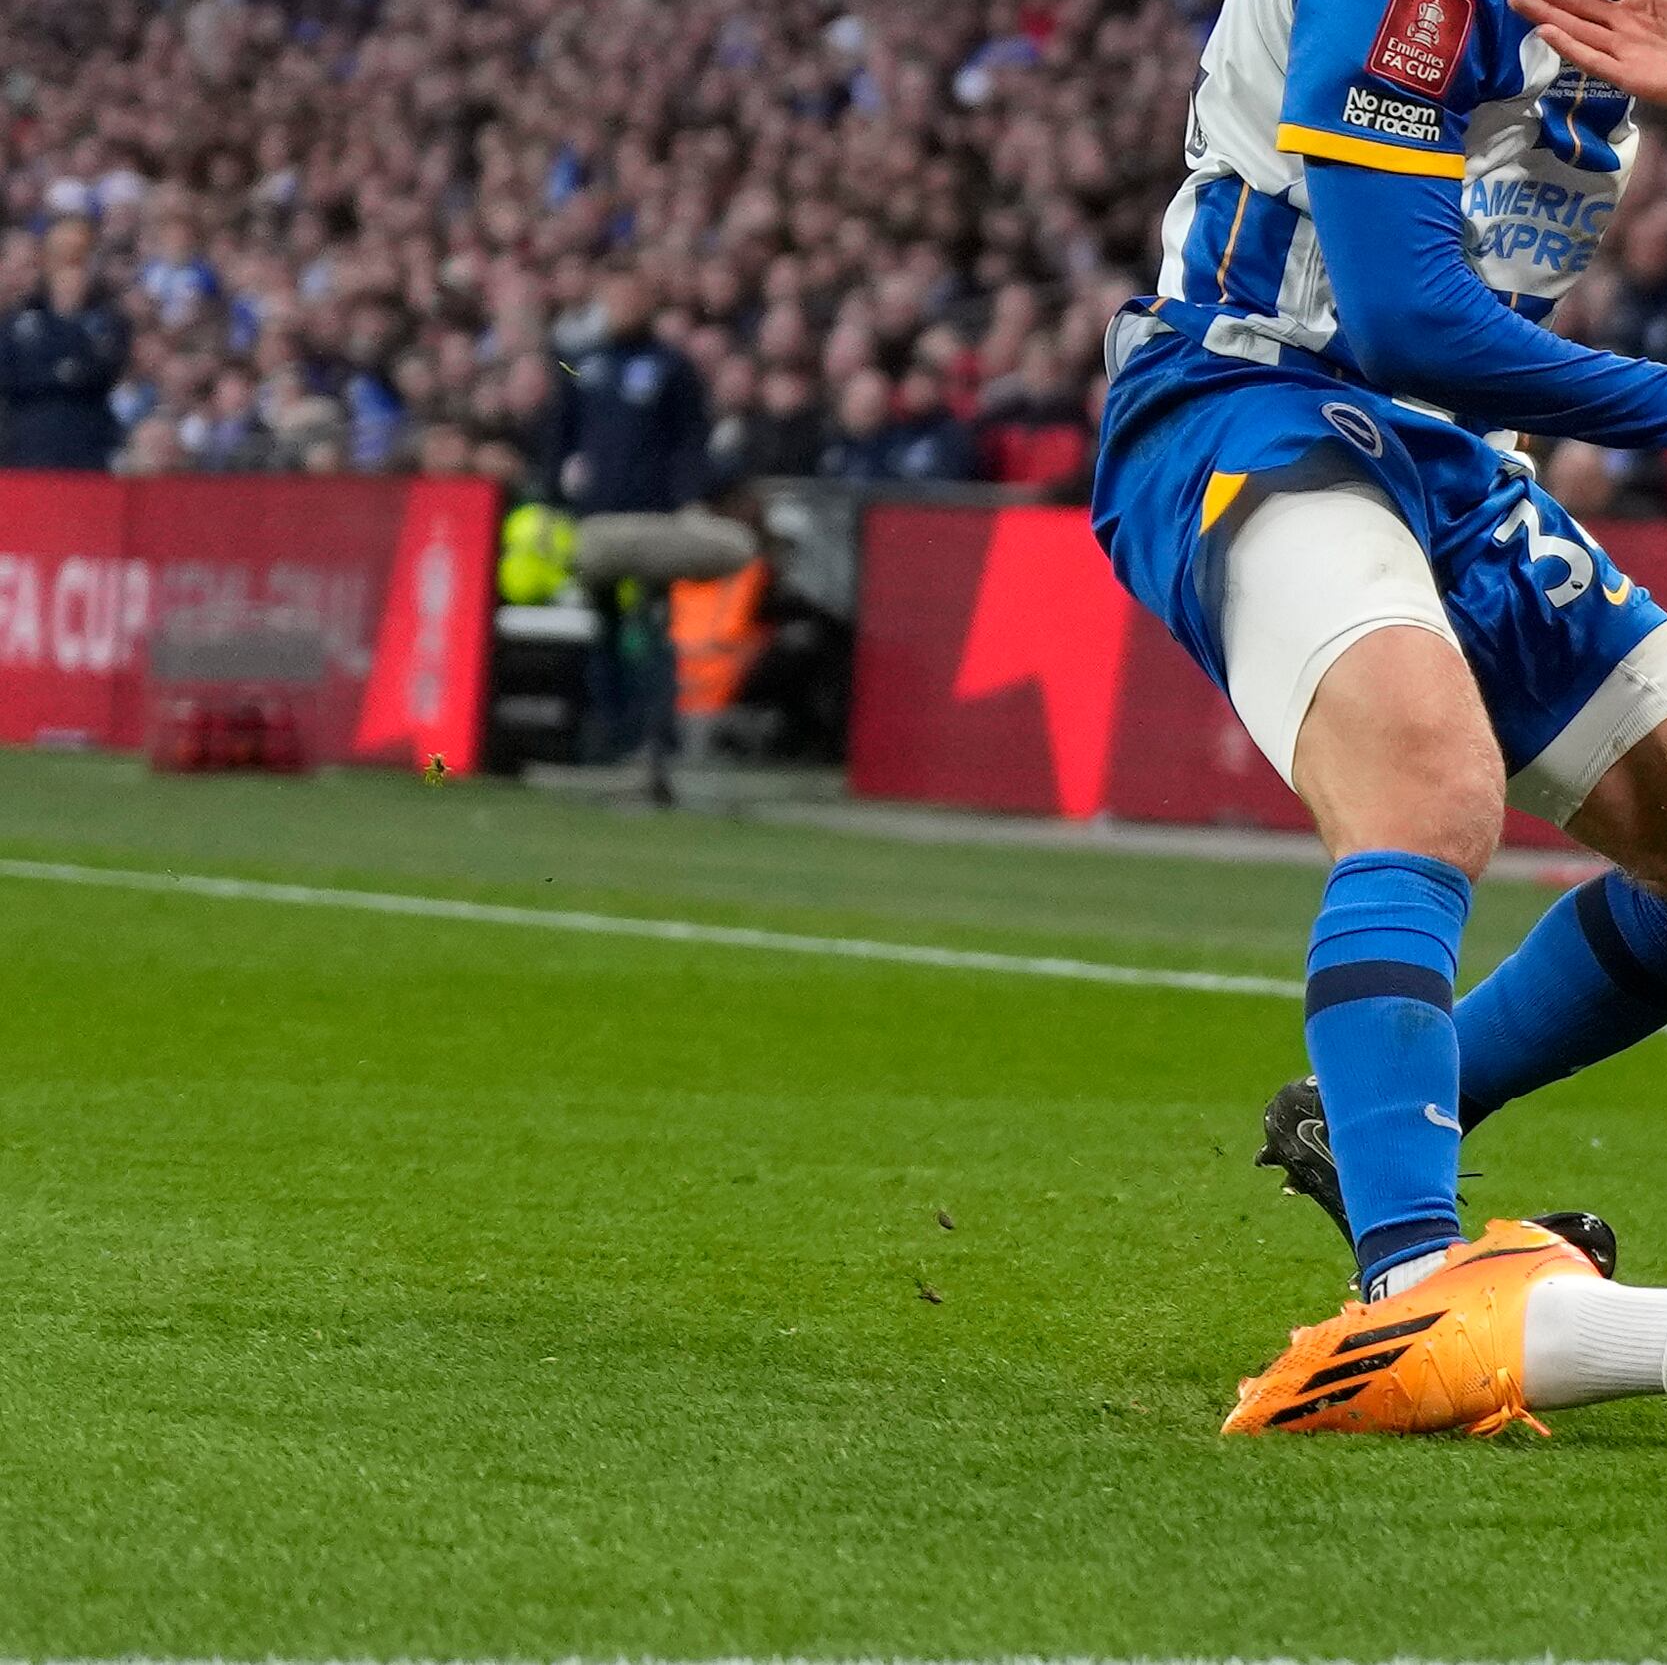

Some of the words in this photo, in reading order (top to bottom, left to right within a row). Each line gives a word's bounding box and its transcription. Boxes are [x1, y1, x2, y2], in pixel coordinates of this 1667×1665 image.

[1382, 51, 1401, 70] FA
[1405, 60, 1441, 83] CUP
[1387, 37, 1445, 69] Emirates
[1347, 87, 1378, 111] No
[1380, 99, 1436, 125] room
[1374, 116, 1440, 143] racism
[54, 554, 149, 672] CUP
